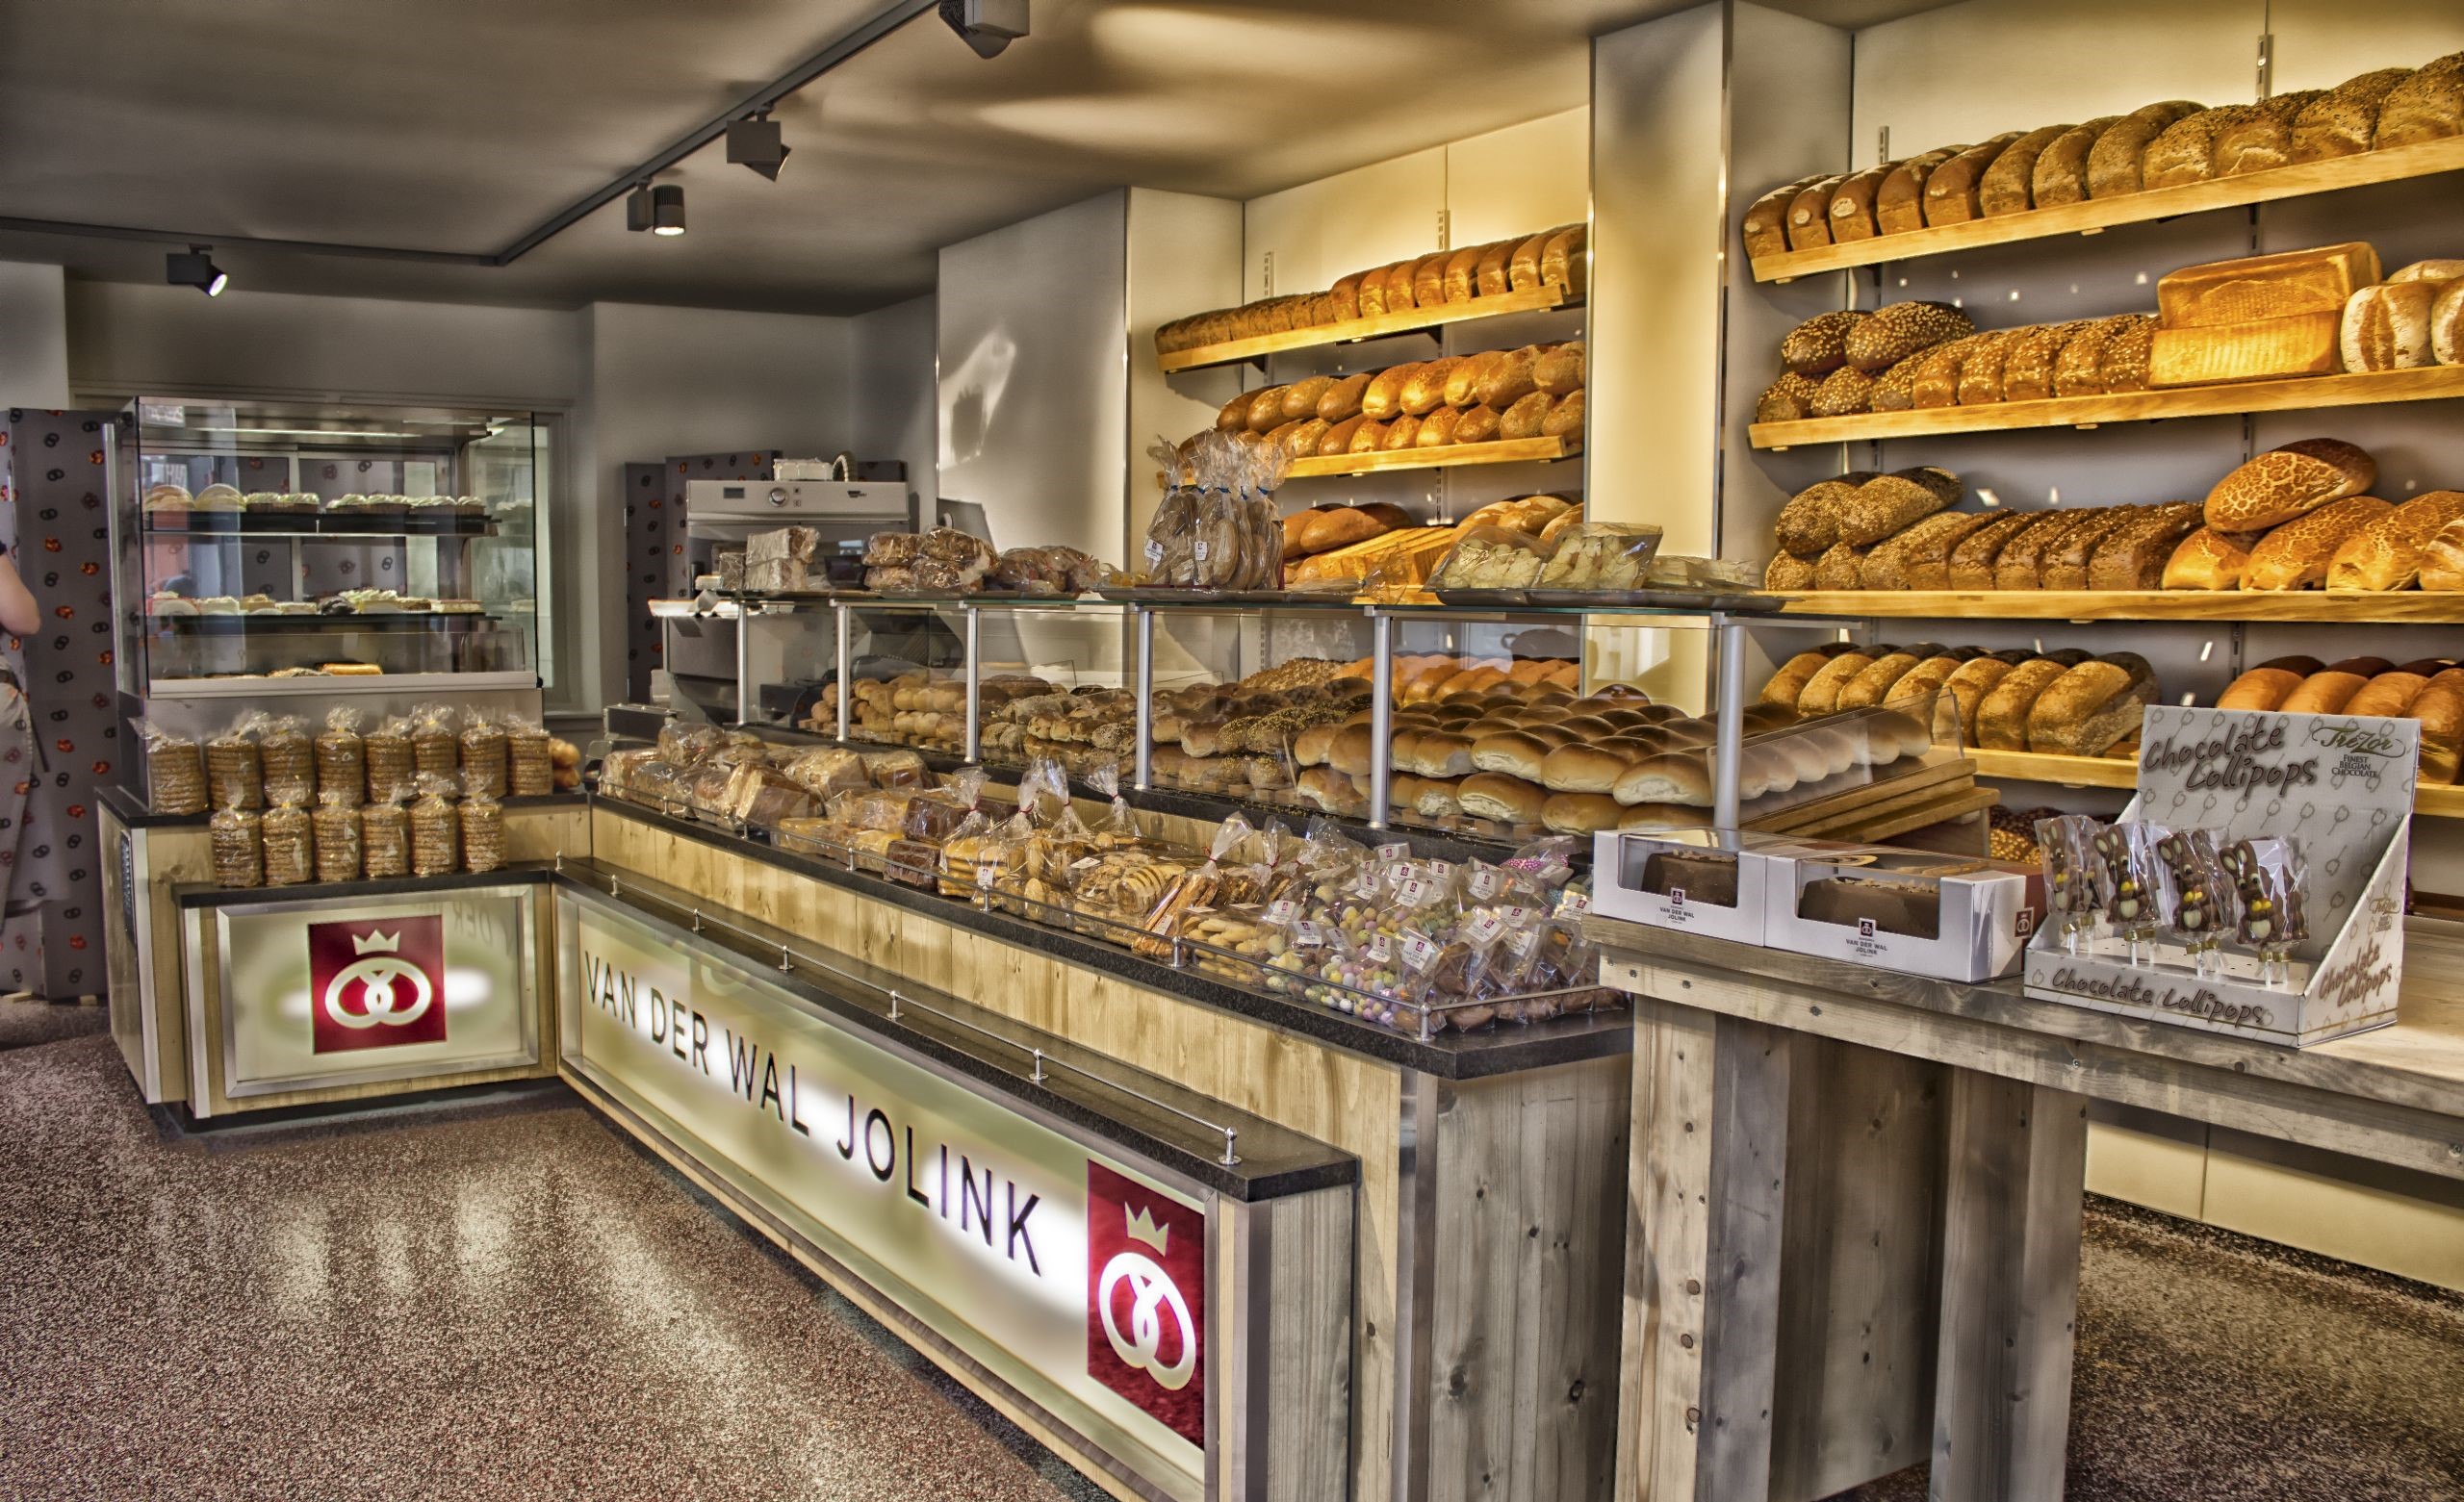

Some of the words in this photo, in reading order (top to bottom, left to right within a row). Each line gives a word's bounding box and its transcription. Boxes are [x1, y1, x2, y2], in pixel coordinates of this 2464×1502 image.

[2144, 715, 2283, 770] Chocolate
[2343, 754, 2369, 763] FINEST
[2186, 754, 2318, 798] Lollipops
[2331, 767, 2380, 778] CHOCOLATE
[2339, 760, 2371, 770] BELGIAN
[2319, 937, 2380, 999] Chocolate
[2337, 963, 2393, 1007] Lollipops
[2052, 967, 2153, 1005] Chocolate
[2162, 987, 2264, 1029] Lollipops
[583, 951, 637, 1029] VAN
[651, 987, 710, 1077] DER
[725, 1028, 810, 1137] WAL
[835, 1093, 1042, 1279] JOLINK
